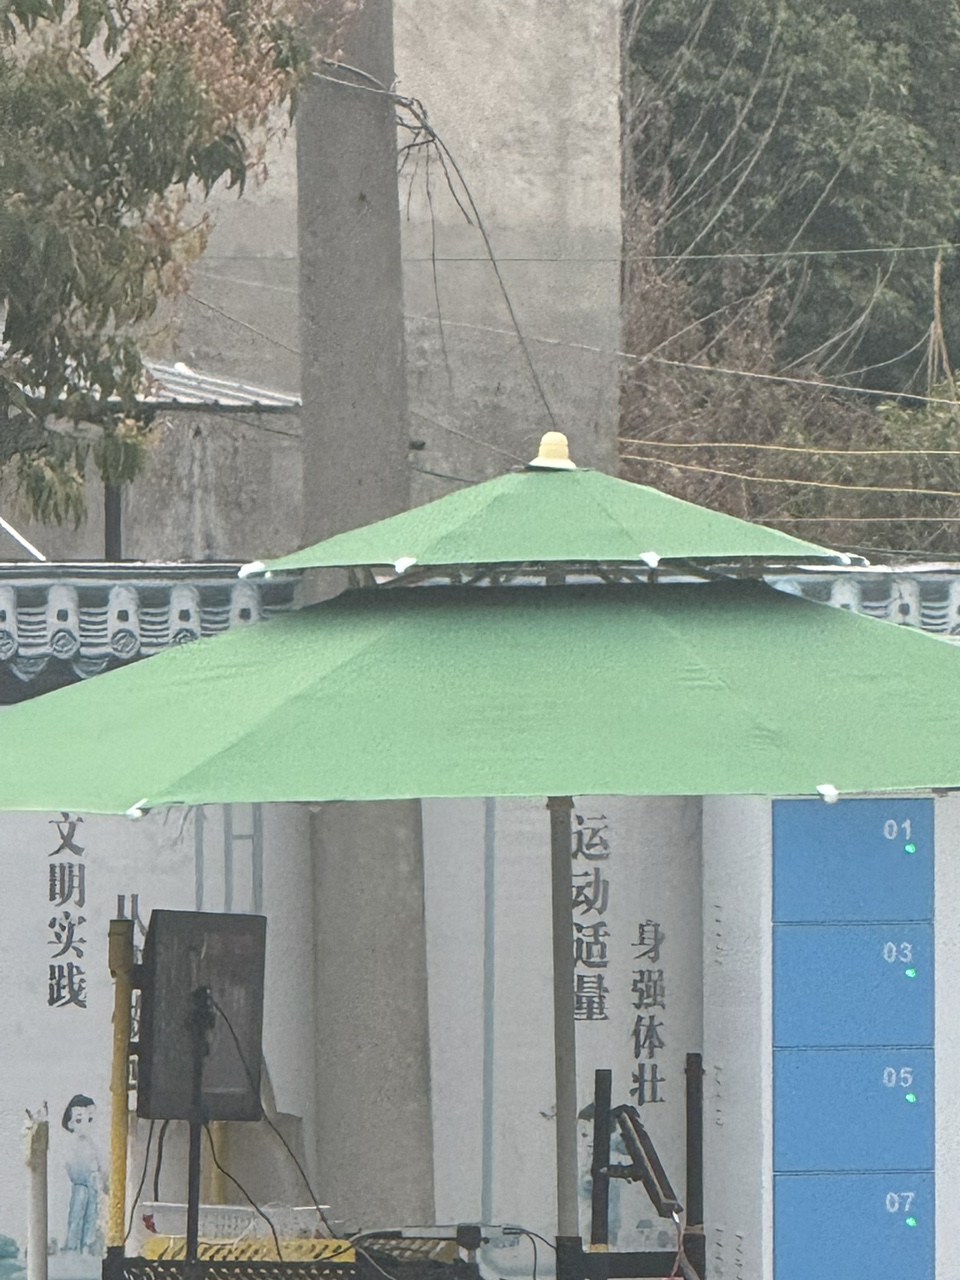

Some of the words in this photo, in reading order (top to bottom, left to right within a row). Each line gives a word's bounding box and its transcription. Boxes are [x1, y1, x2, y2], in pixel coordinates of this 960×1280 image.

[883, 819, 912, 840] 01
[47, 811, 88, 1009] 文明实践
[571, 814, 610, 1021] 运动适量
[883, 942, 912, 963] 03
[629, 919, 666, 1106] 身强体壮
[883, 1067, 913, 1087] 05
[886, 1192, 915, 1213] 07
